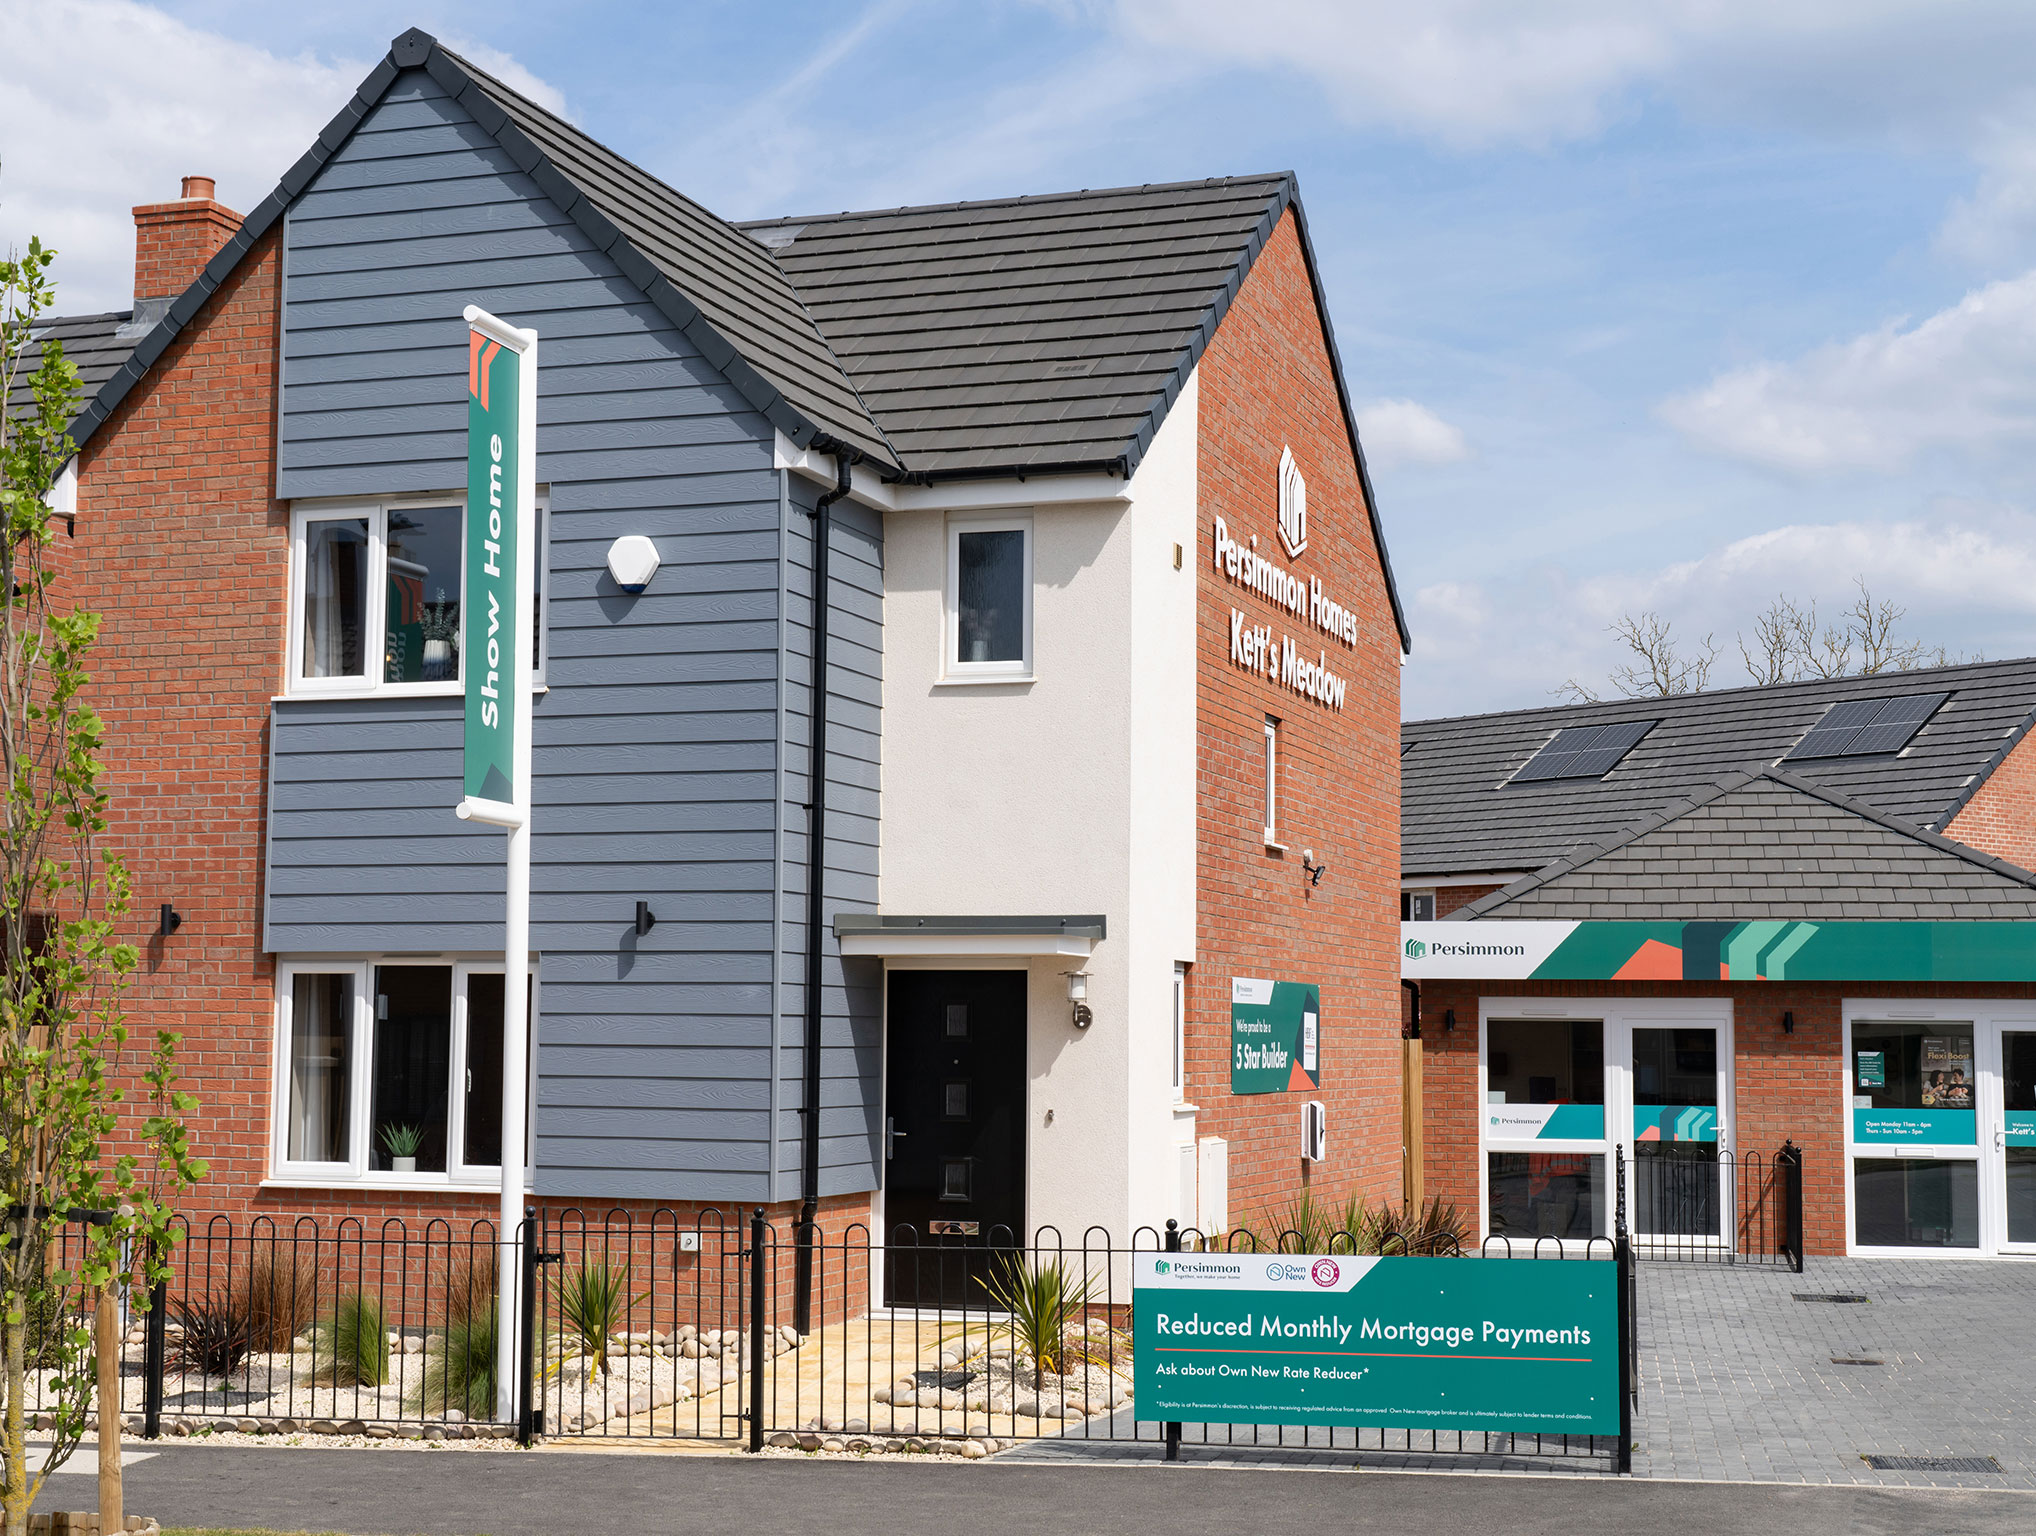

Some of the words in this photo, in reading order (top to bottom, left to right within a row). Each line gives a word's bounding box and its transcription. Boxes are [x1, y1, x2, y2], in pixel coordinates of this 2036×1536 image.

[484, 433, 502, 578] Home
[1215, 515, 1306, 617] Persimmon
[1310, 574, 1357, 646] Homes
[480, 590, 500, 730] Show
[1231, 607, 1278, 679] Kett's
[1282, 635, 1346, 710] Meadow
[1432, 941, 1525, 956] Persimmon
[1236, 1043, 1242, 1070] 5
[1244, 1043, 1261, 1070] Star
[1262, 1041, 1288, 1069] Builder
[1927, 1052, 1947, 1060] Flexi
[1947, 1052, 1970, 1060] Boost
[1501, 1117, 1542, 1125] Persimmon
[1865, 1120, 1880, 1128] Open
[1174, 1262, 1241, 1273] Persimmon
[1285, 1264, 1306, 1273] Own
[1285, 1272, 1306, 1281] New
[1157, 1312, 1252, 1336] Reduced
[1260, 1315, 1352, 1344] Monthly
[1360, 1317, 1474, 1348] Mortgage
[1482, 1320, 1591, 1349] Payments
[1155, 1362, 1178, 1375] Ask
[1181, 1363, 1215, 1376] about
[1218, 1364, 1248, 1377] Own
[1251, 1365, 1280, 1378] New
[1283, 1366, 1310, 1379] Rate
[1475, 1410, 1498, 1418] ultimately
